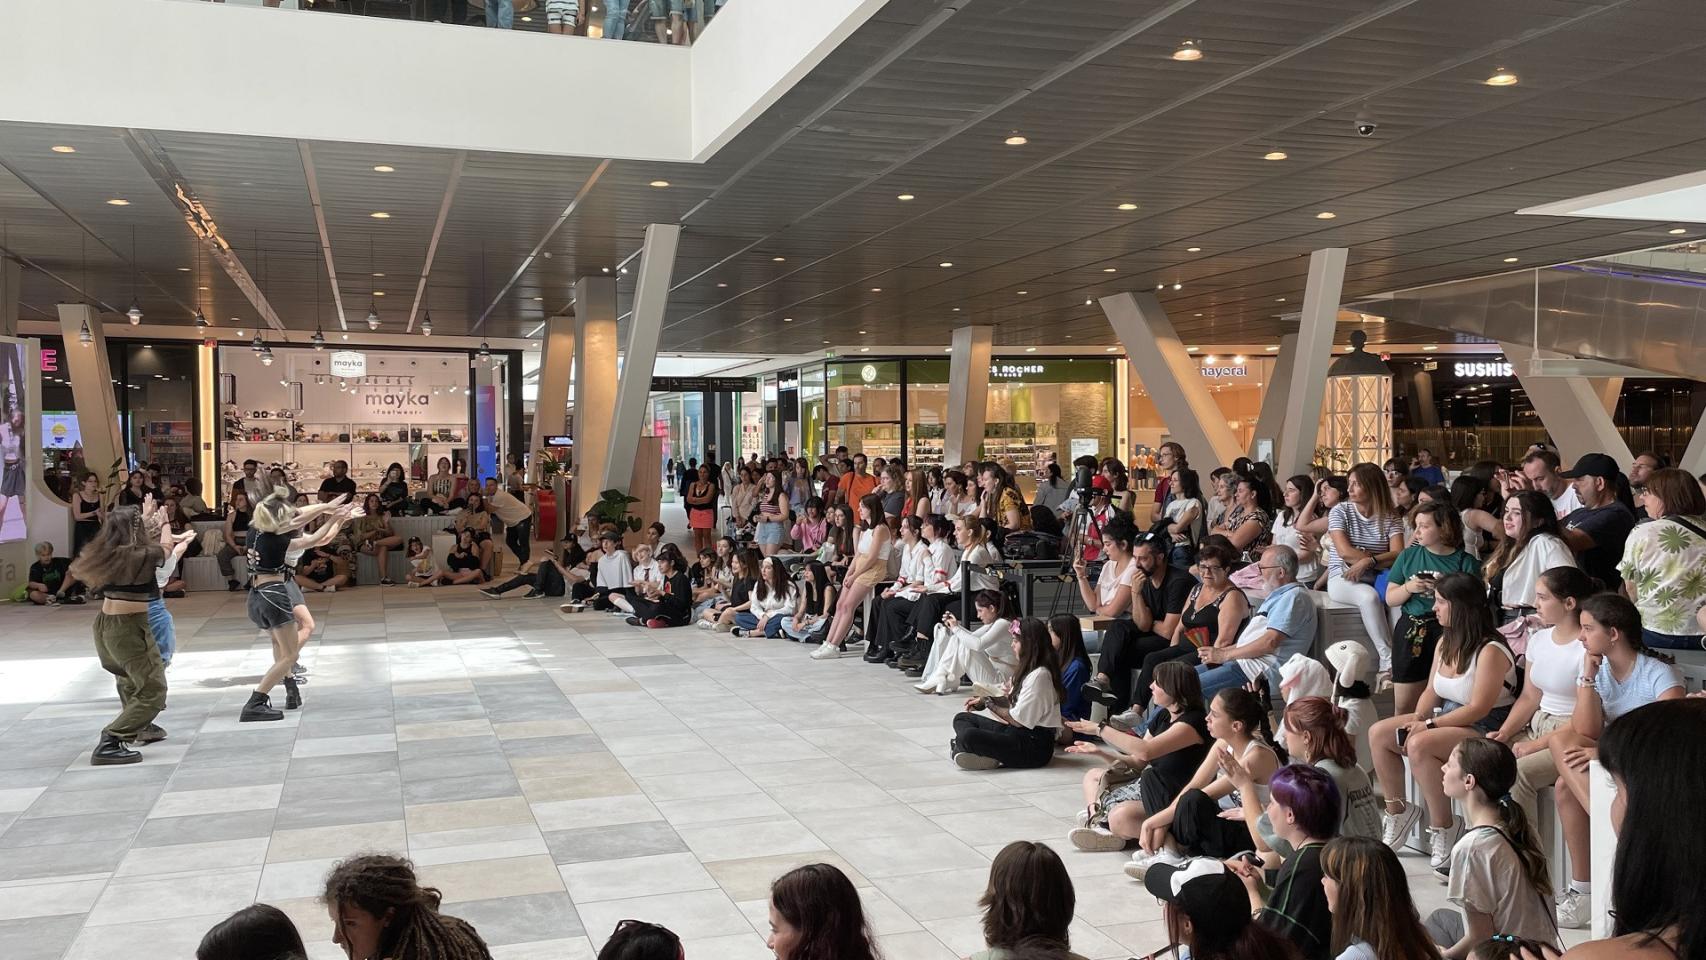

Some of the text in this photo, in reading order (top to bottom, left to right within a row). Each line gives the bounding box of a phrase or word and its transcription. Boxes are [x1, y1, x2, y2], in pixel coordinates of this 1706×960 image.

[334, 360, 363, 368] mayka
[1002, 365, 1044, 373] ROCHER
[1454, 362, 1514, 378] SUSHIS
[365, 391, 429, 408] mayka
